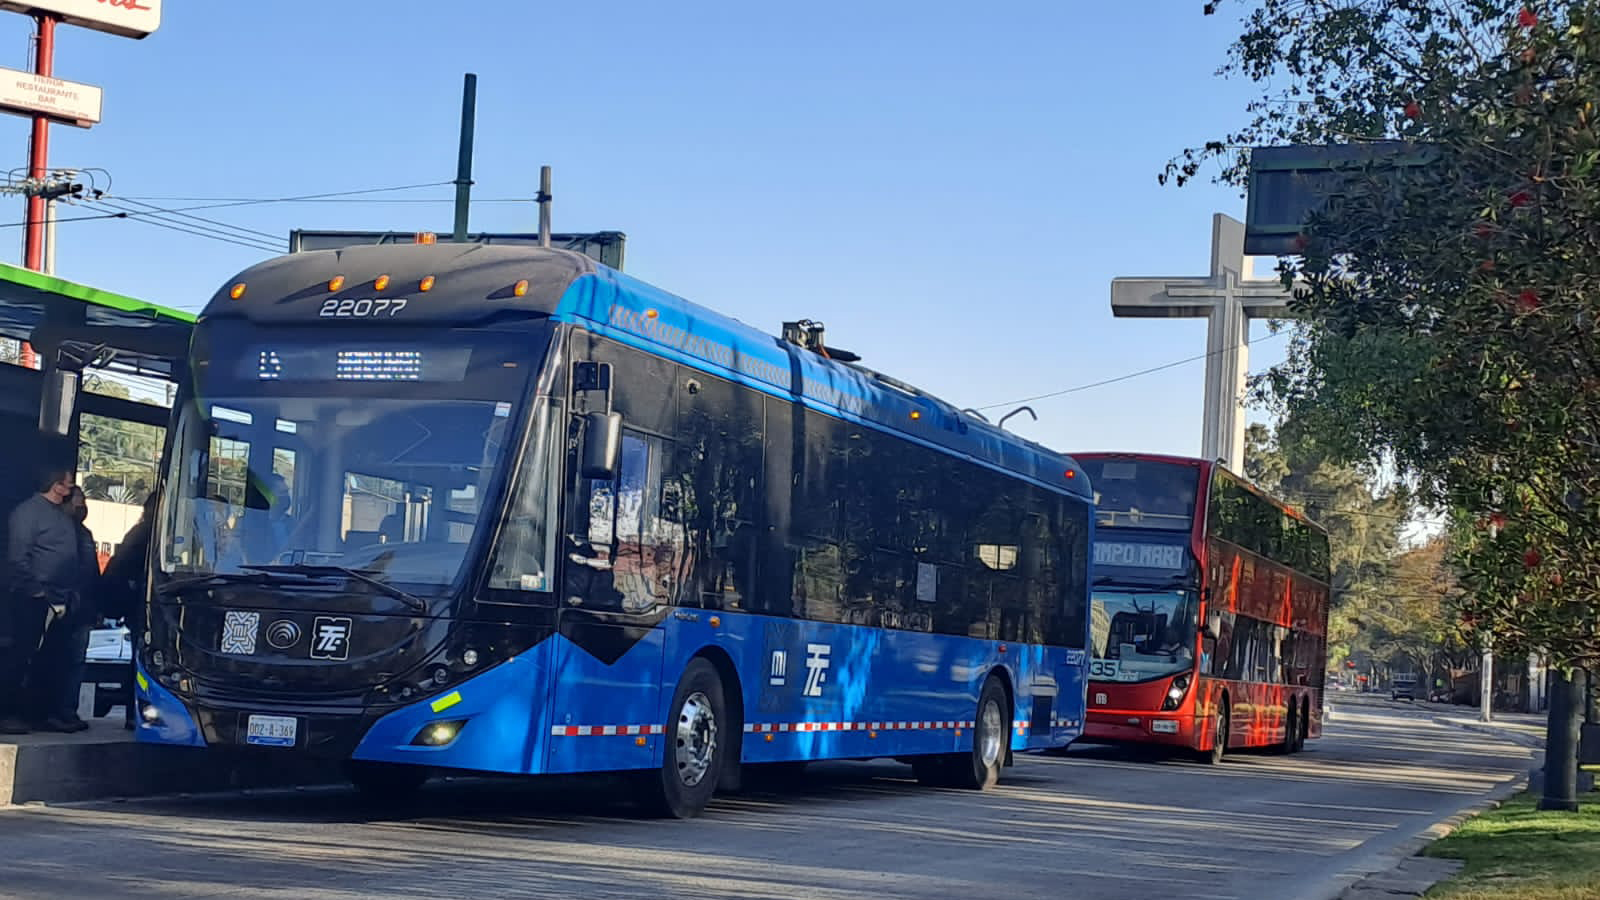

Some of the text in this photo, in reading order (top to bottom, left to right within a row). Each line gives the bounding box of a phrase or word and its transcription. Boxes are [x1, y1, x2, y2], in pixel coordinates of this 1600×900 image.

[16, 80, 79, 100] RESTAURANTE
[38, 95, 57, 105] BAR
[319, 299, 408, 317] 22077
[1087, 660, 1116, 677] 35
